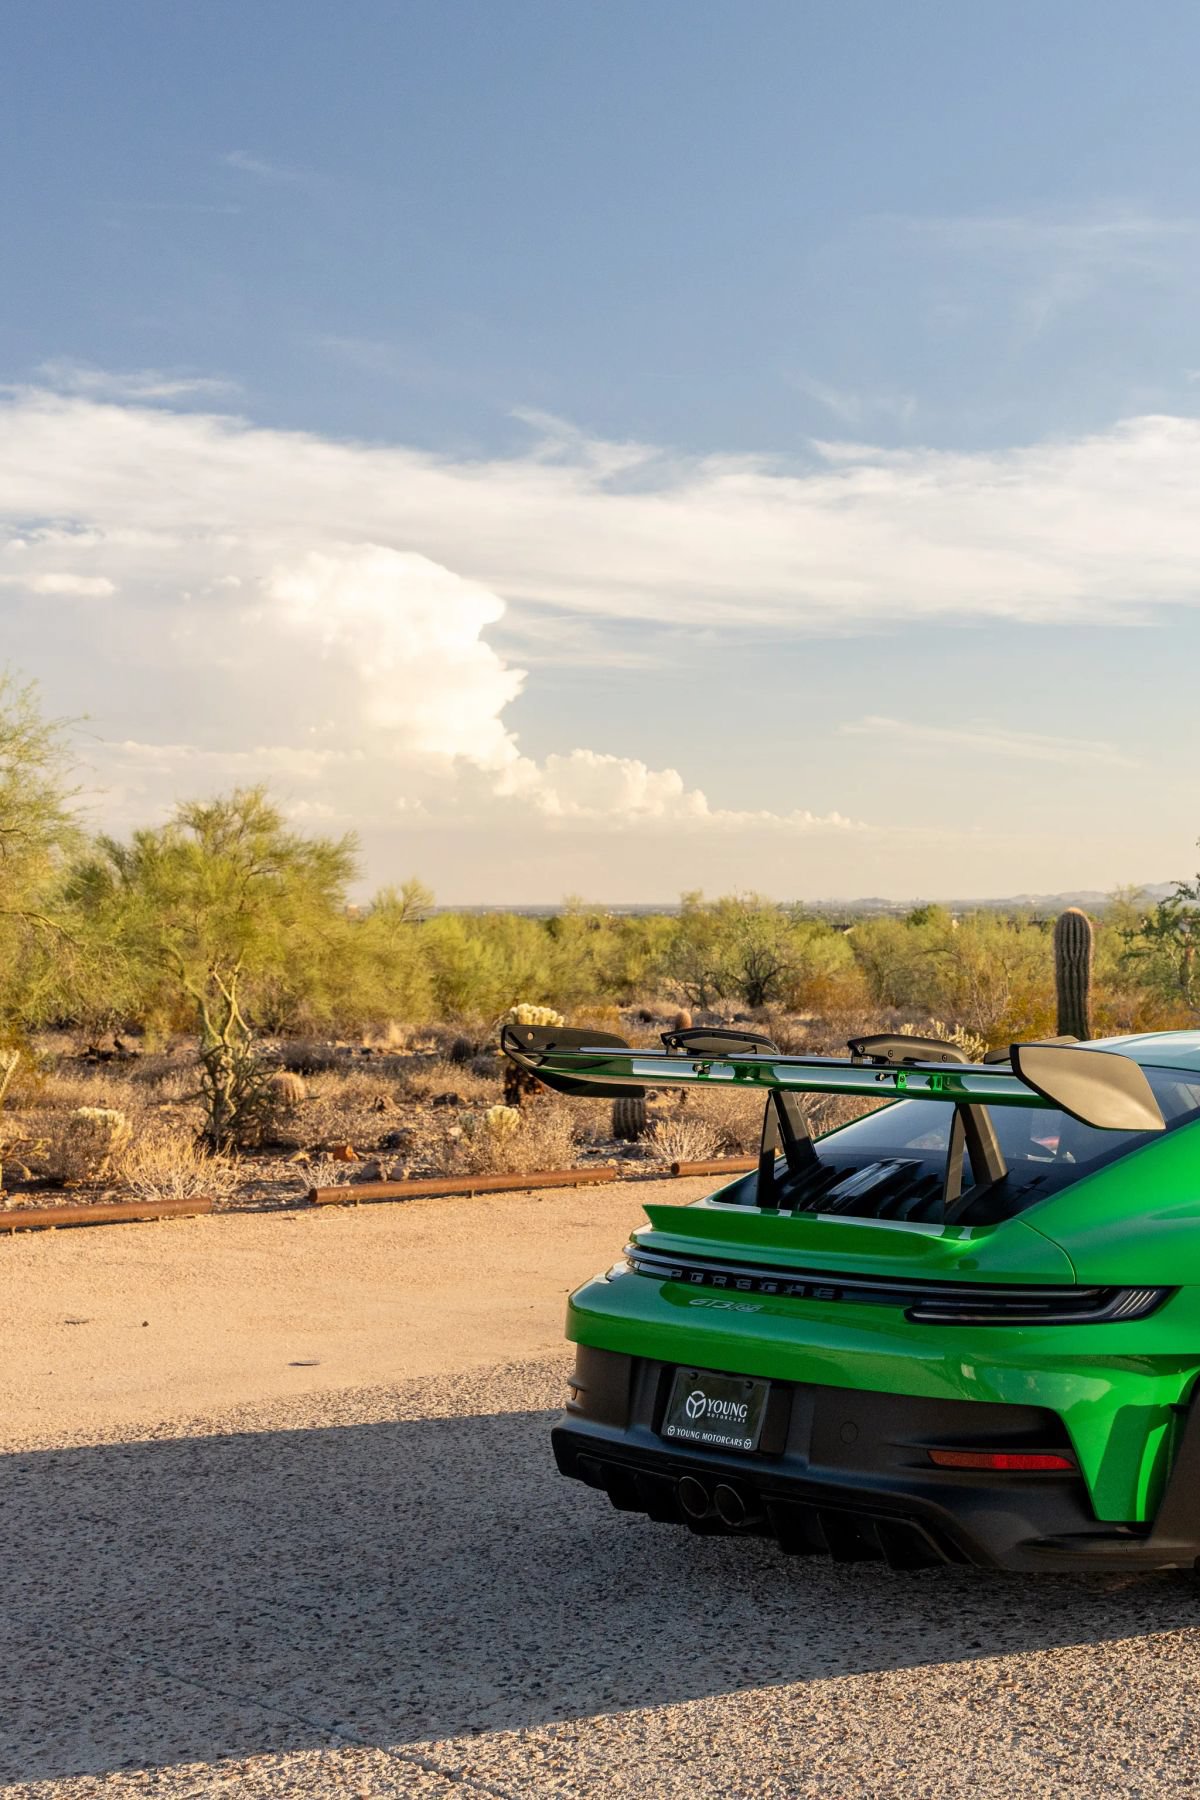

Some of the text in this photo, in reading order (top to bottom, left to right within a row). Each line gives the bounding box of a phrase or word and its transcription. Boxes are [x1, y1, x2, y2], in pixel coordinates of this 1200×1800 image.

[671, 1269, 836, 1299] PORSCHE
[706, 1412, 746, 1423] MOTORCARS
[707, 1398, 748, 1418] YOUNG
[676, 1428, 743, 1447] YOUNG MOTORCARS
